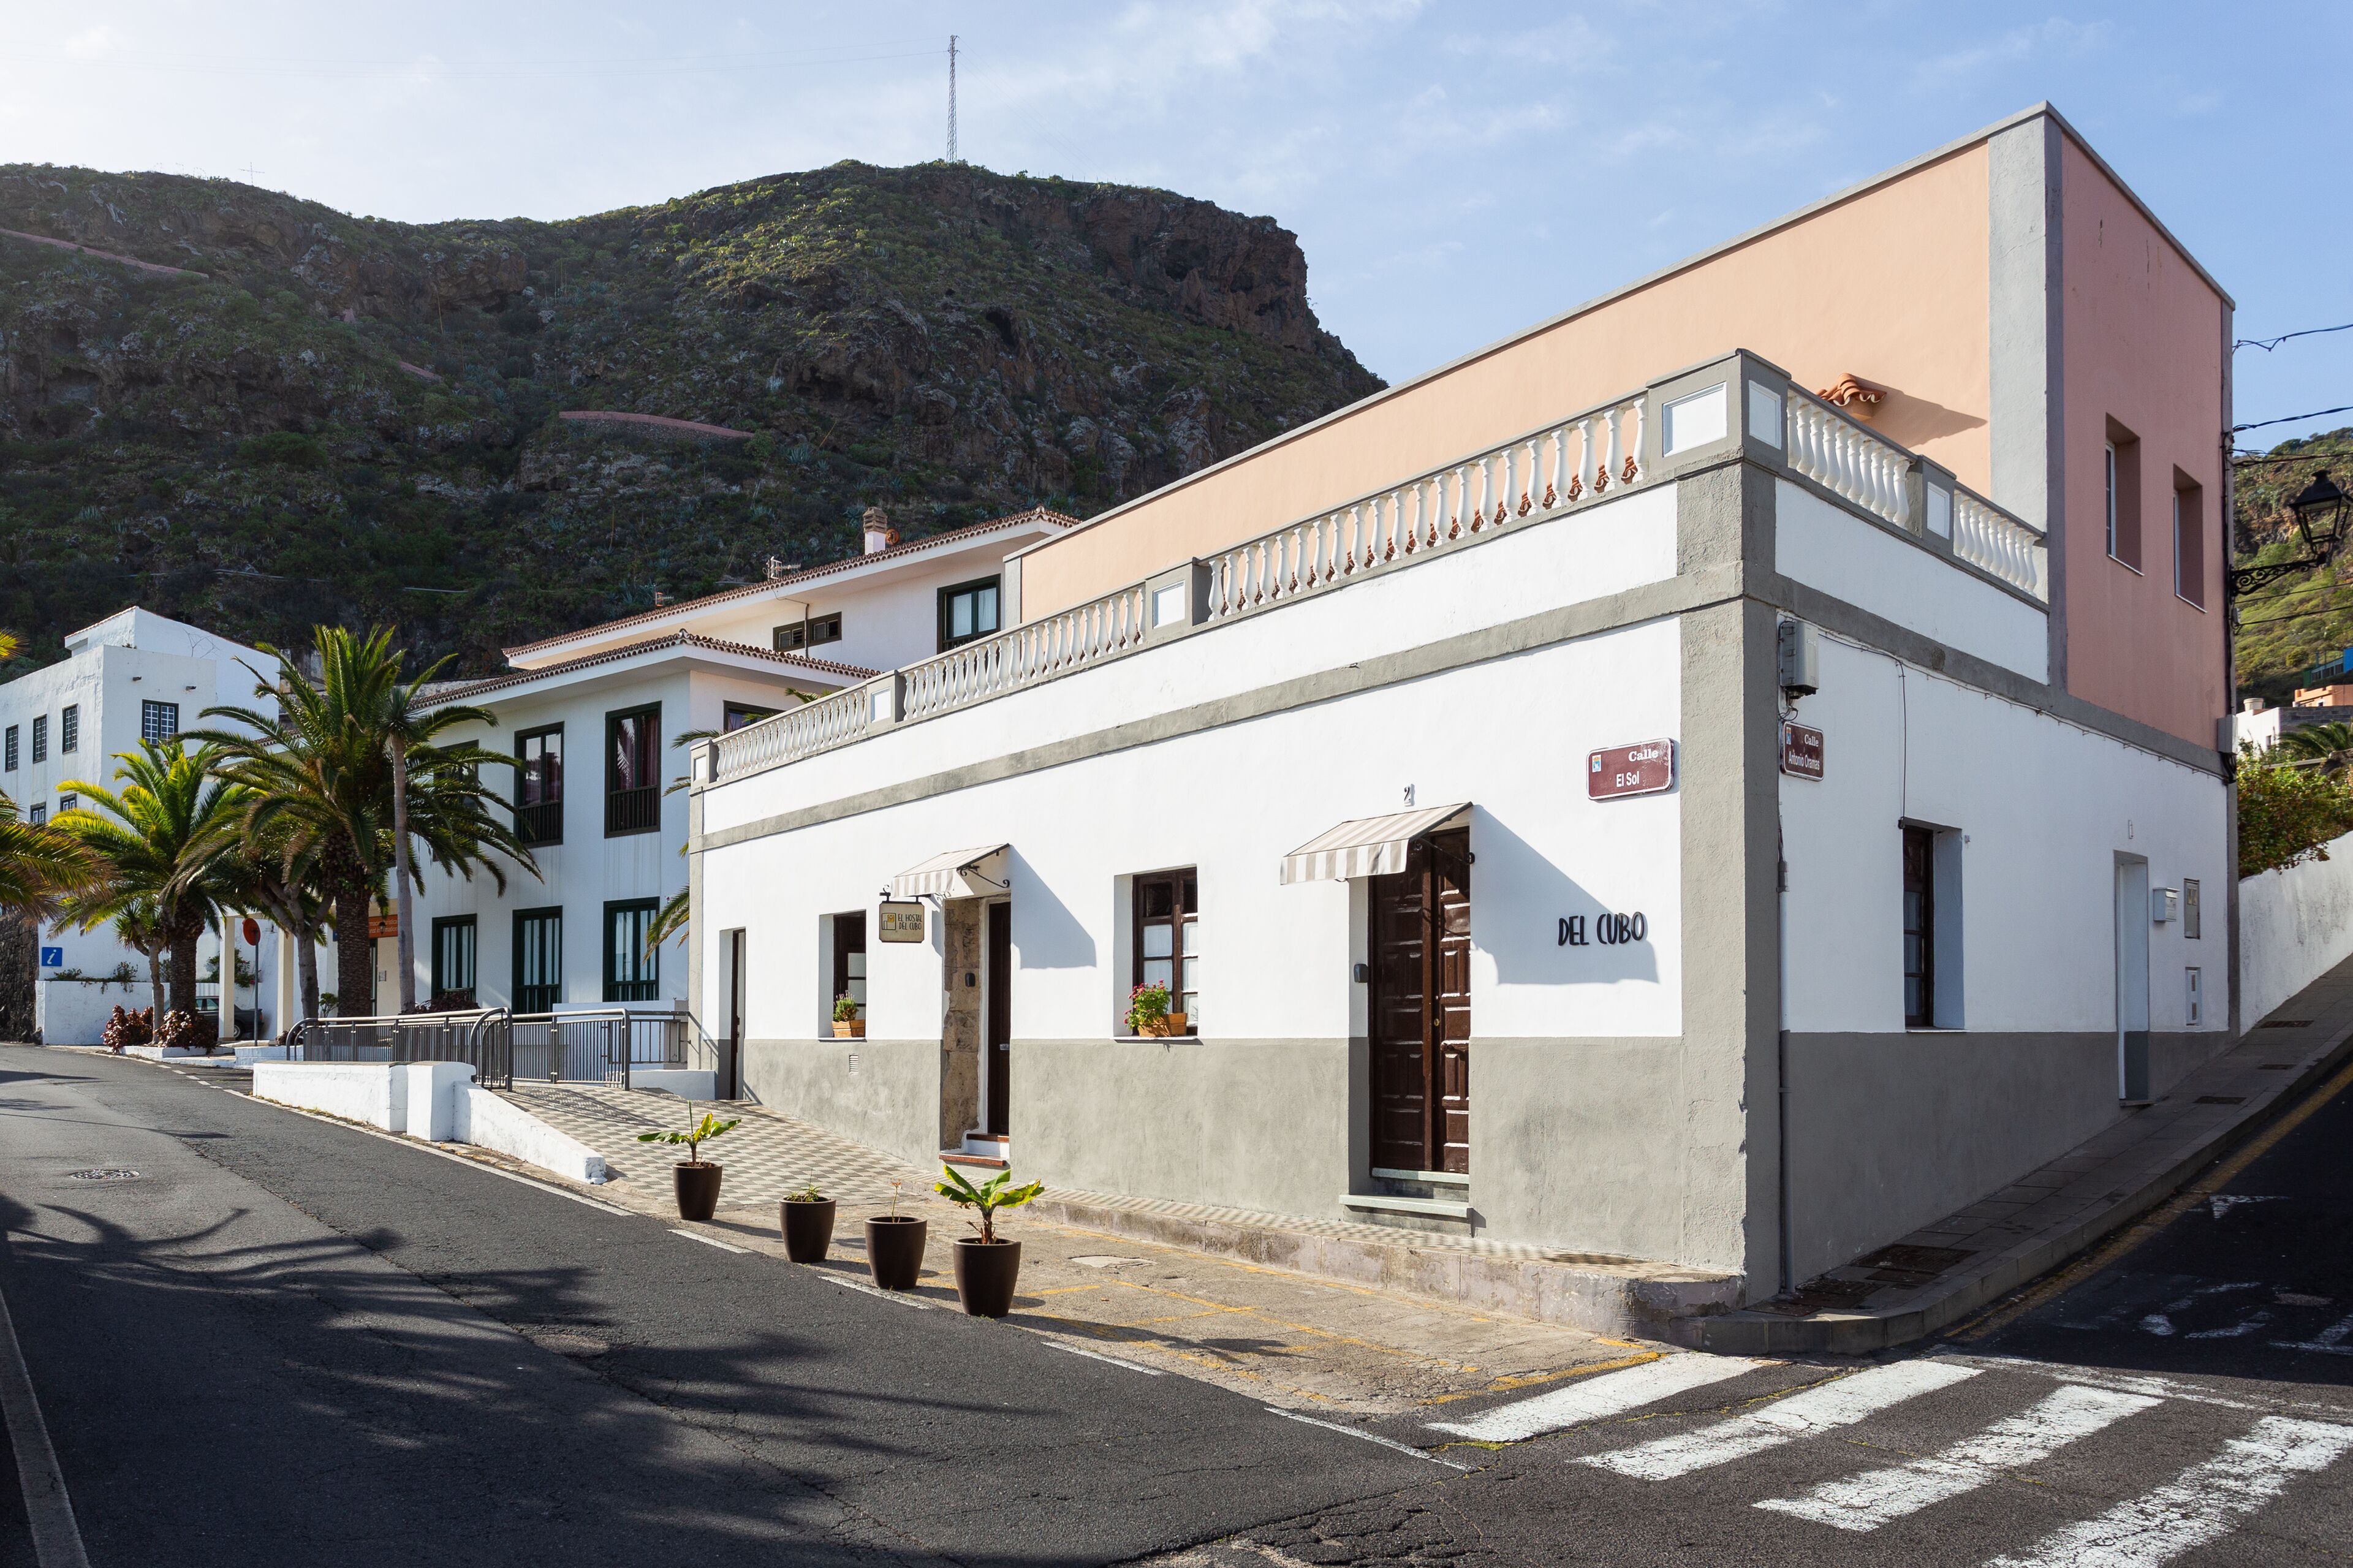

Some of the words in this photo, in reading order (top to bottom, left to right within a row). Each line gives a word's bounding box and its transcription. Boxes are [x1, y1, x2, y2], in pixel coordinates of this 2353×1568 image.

[1805, 734, 1819, 747] Calle
[1628, 748, 1659, 762] Calle
[1789, 751, 1804, 767] Antonio
[1805, 754, 1820, 770] Oramas
[1616, 773, 1624, 787] El
[1626, 771, 1640, 786] Sol
[905, 914, 922, 922] HOSTAL
[1558, 915, 1590, 946] DEL
[1596, 911, 1645, 945] CUBO
